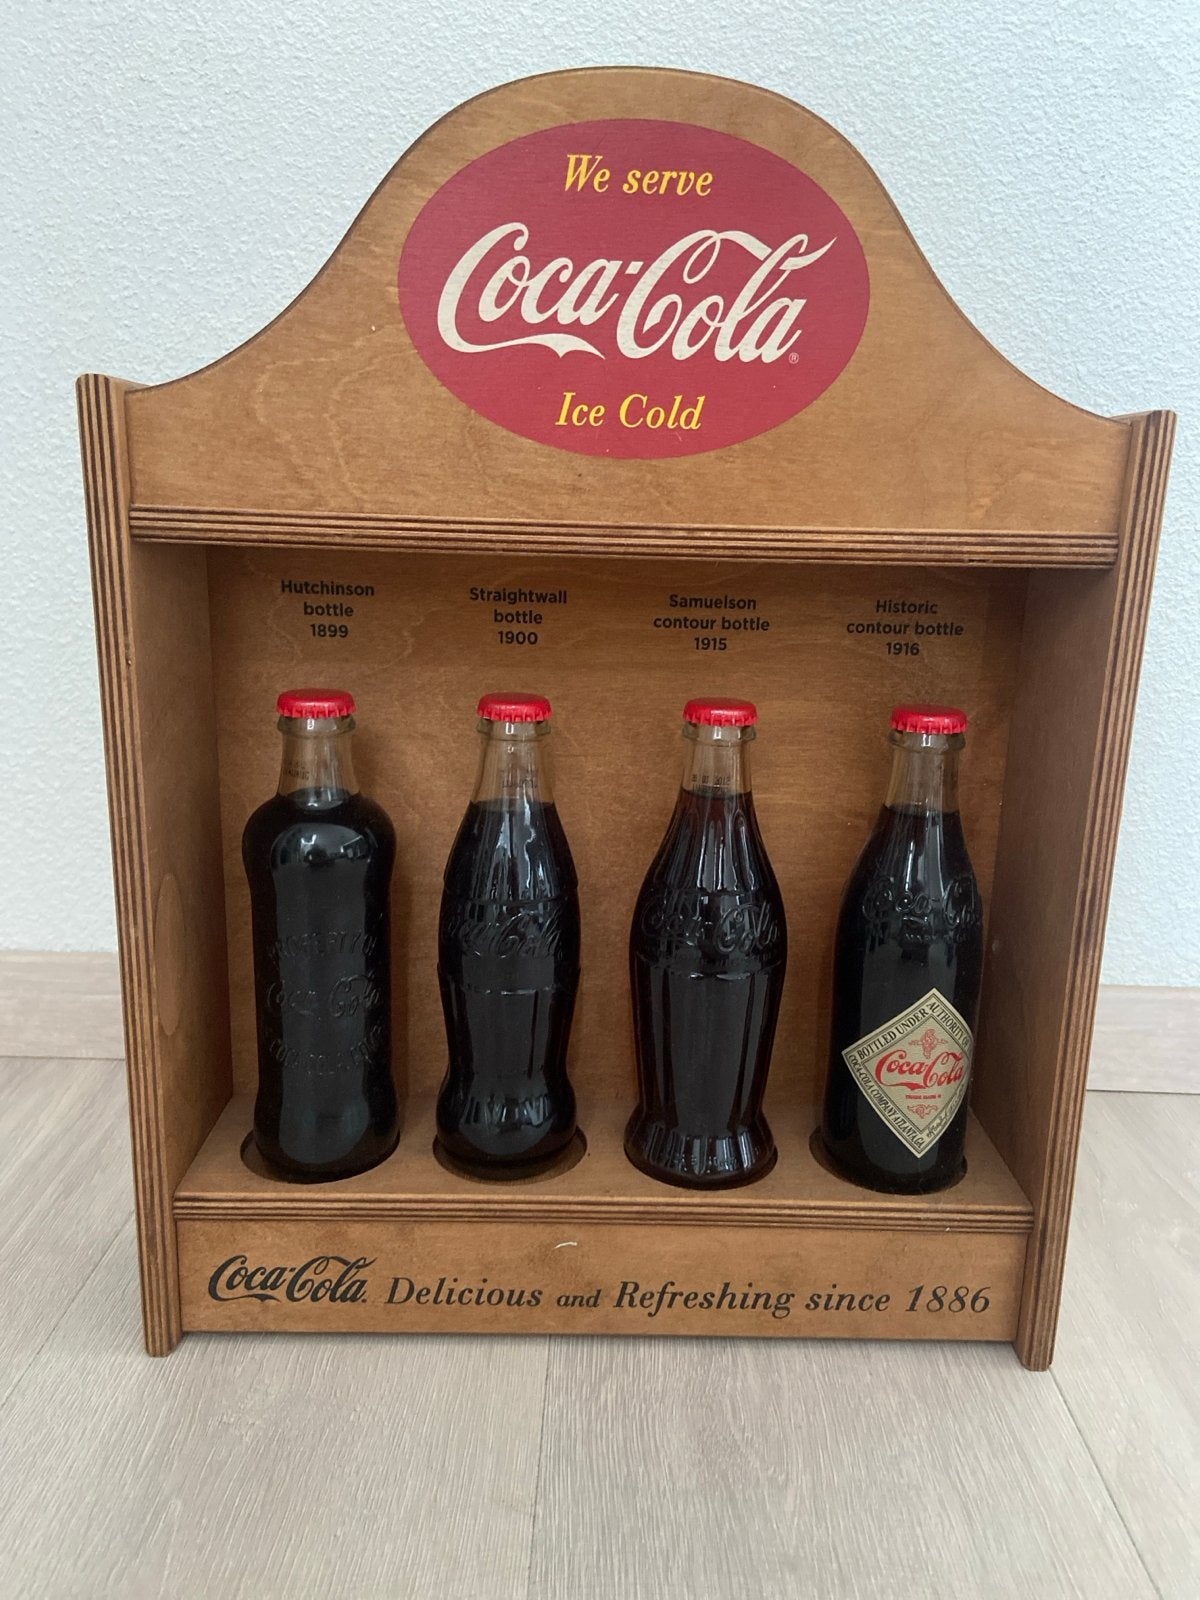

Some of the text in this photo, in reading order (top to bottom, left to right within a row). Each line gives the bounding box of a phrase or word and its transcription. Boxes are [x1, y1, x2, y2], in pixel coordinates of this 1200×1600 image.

[564, 154, 714, 196] We serve
[437, 222, 837, 363] Coca-Cola
[555, 392, 705, 430] Ice Cold
[280, 579, 375, 598] Hutchinson
[469, 586, 568, 605] Straightwall
[303, 602, 354, 618] bottle
[669, 593, 757, 611] Samuelson
[875, 599, 938, 615] Historic
[493, 609, 543, 625] bottle
[653, 616, 770, 632] contour bottle
[310, 623, 349, 639] 1899
[846, 620, 964, 637] contour bottle
[498, 630, 539, 646] 1900
[693, 636, 728, 652] 1915
[885, 641, 920, 657] 1916
[926, 1002, 964, 1040] AUTHORITY
[857, 1008, 929, 1060] BOTTLED UNDER
[875, 1049, 965, 1090] Coca-Cola
[849, 1054, 875, 1090] COCA-COLA
[870, 1089, 899, 1118] COMPANY
[208, 1254, 992, 1319] Coca-Cola Delicious and Refreshing since 1886
